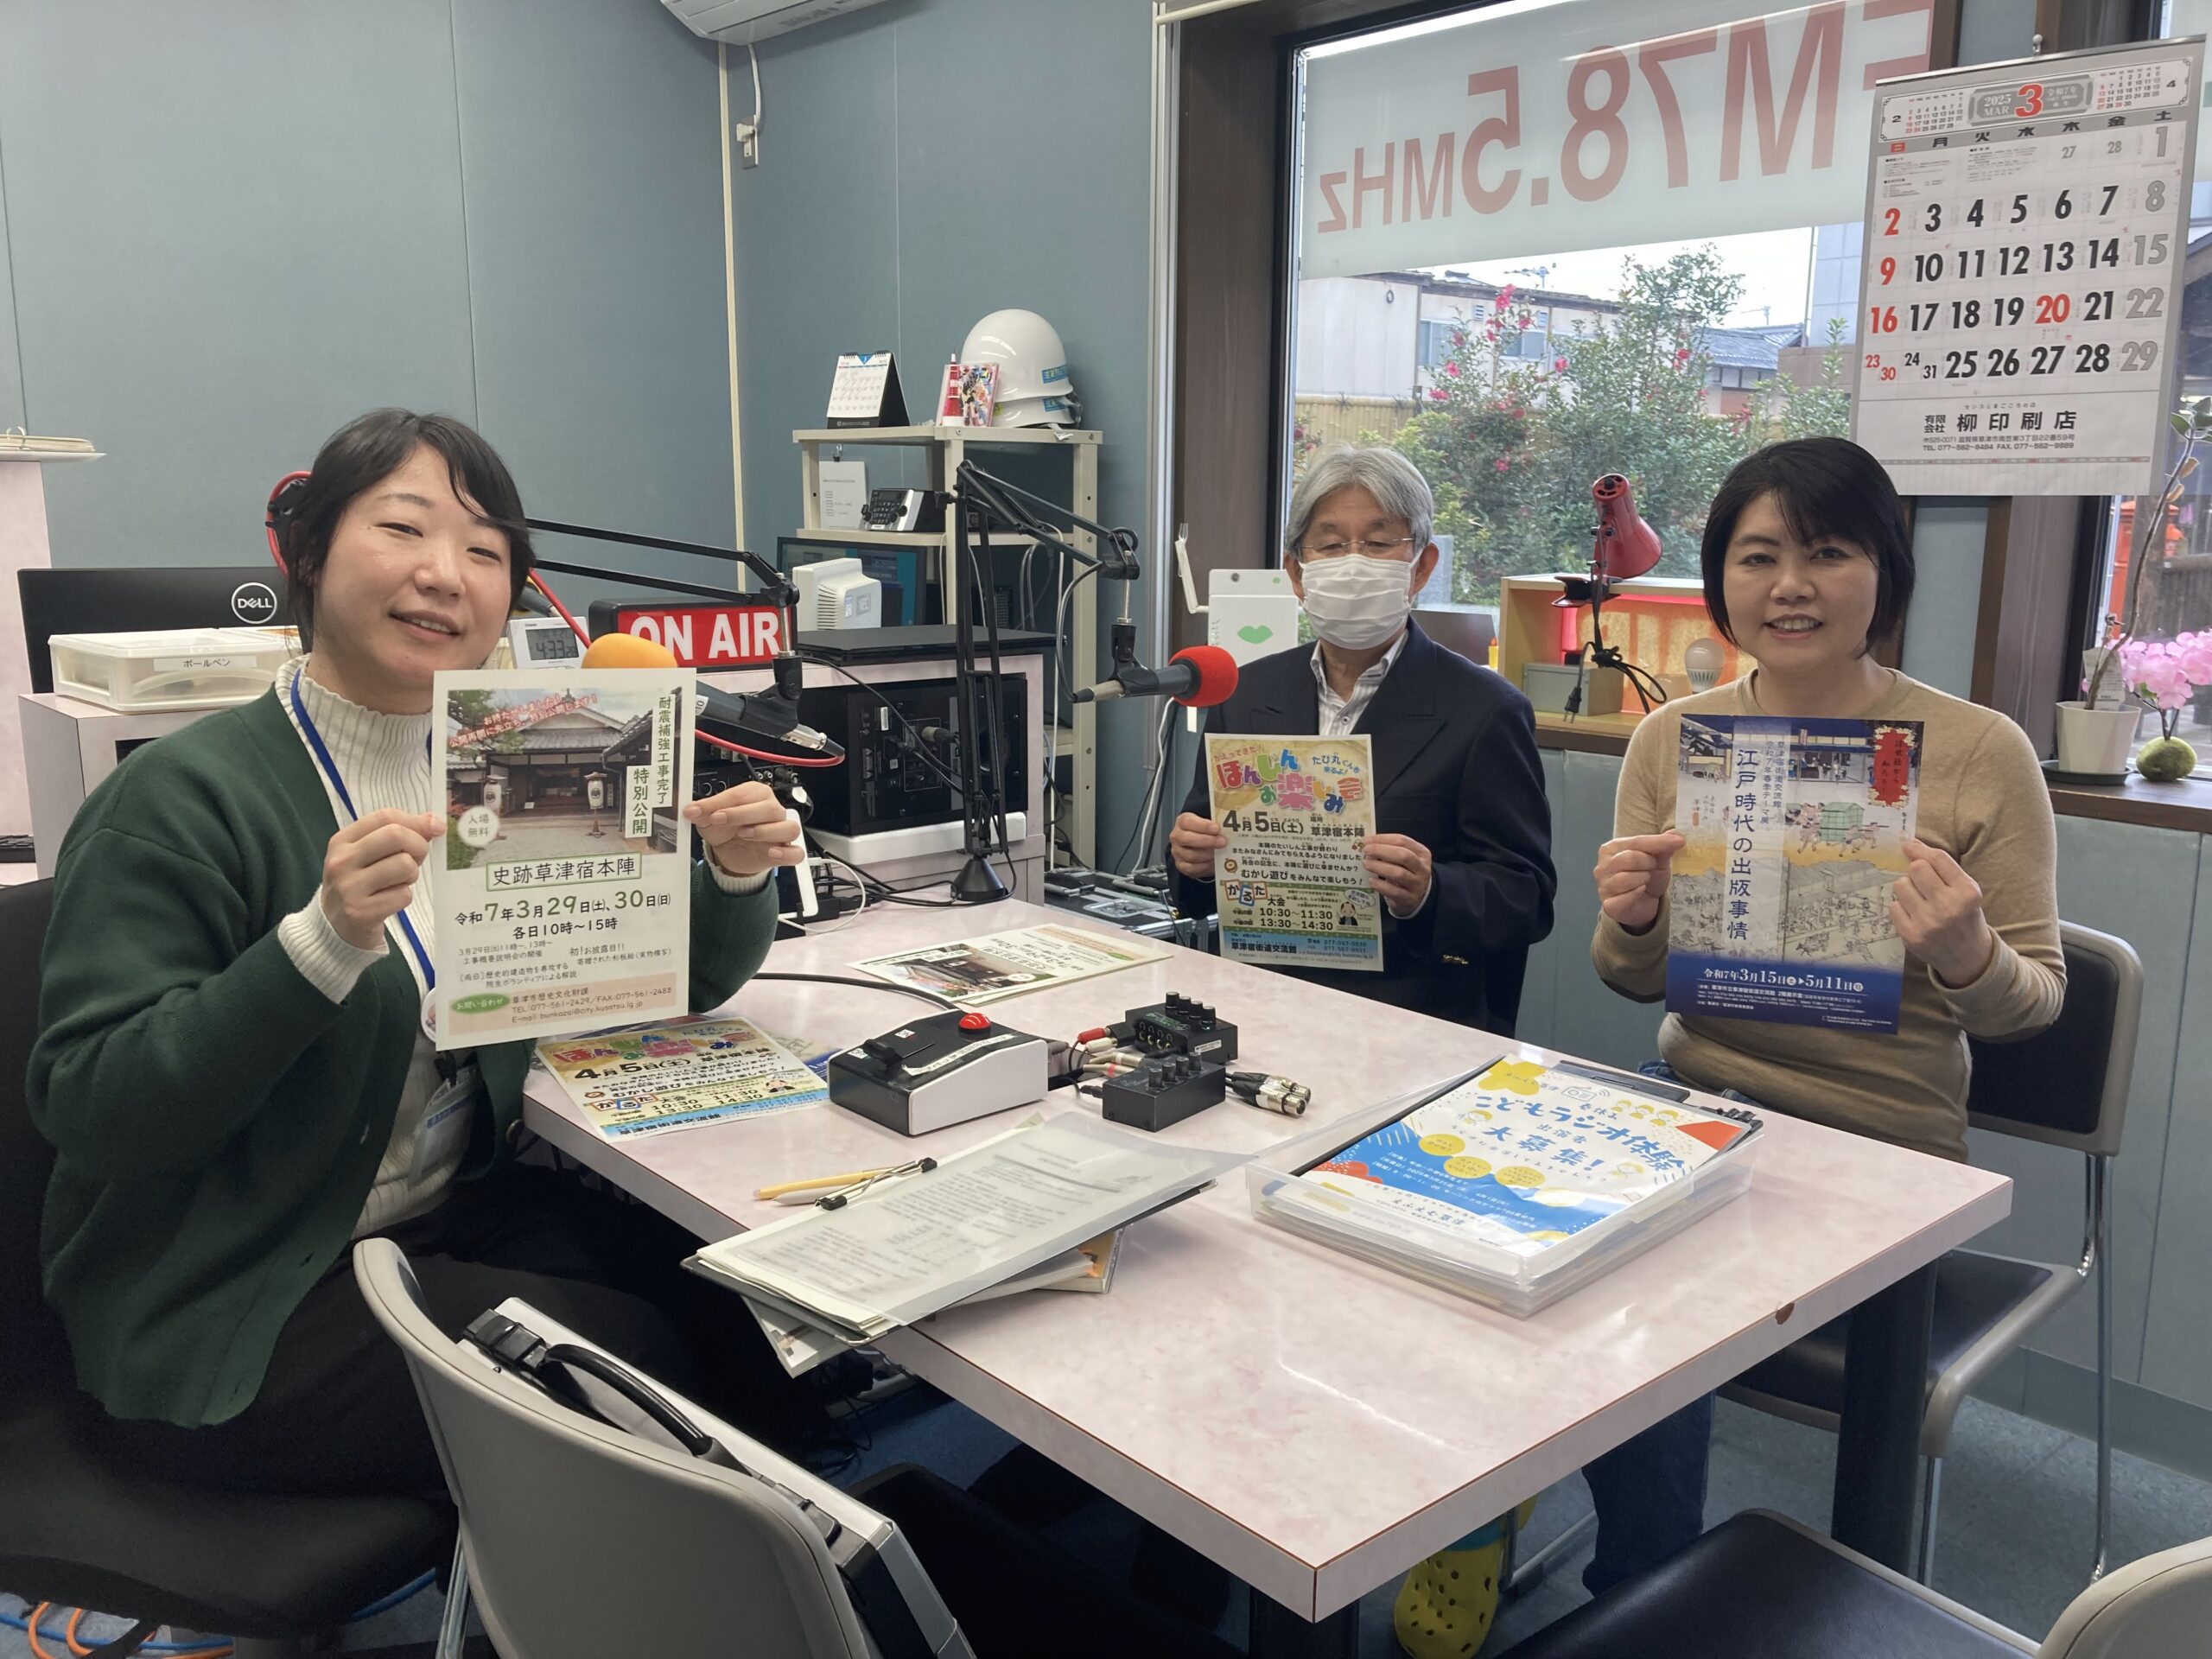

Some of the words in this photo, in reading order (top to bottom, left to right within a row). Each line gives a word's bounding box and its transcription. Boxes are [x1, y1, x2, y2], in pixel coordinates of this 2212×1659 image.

[1984, 93, 2012, 107] 2025
[1984, 106, 2010, 117] MAR
[2015, 84, 2044, 118] 3
[1891, 143, 1905, 153] 日
[1932, 137, 1948, 148] 月
[1974, 132, 1990, 143] 火
[2018, 127, 2035, 137] 水
[2063, 122, 2080, 132] 木
[2107, 116, 2126, 127] 金
[2154, 111, 2172, 122] 土
[2061, 145, 2076, 159] 27
[2107, 141, 2122, 154] 28
[2156, 126, 2168, 157] 1
[1884, 207, 1901, 236] 2
[1925, 204, 1942, 232] 3
[1967, 199, 1984, 227] 4
[2010, 194, 2028, 224] 5
[2055, 189, 2072, 219] 6
[2099, 185, 2119, 215] 7
[2145, 180, 2164, 213] 8
[1880, 257, 1896, 285] 9
[1915, 253, 1943, 283] 10
[1959, 250, 1985, 278] 11
[1999, 246, 2030, 275] 12
[2044, 241, 2074, 272] 13
[2088, 238, 2119, 269] 14
[2133, 234, 2169, 265] 15
[1871, 306, 1897, 334] 16
[1910, 303, 1940, 332] 17
[1951, 301, 1980, 329] 18
[1994, 297, 2024, 327] 19
[2036, 294, 2070, 324] 20
[2083, 291, 2113, 321] 21
[2126, 288, 2164, 319] 22
[1866, 354, 1880, 368] 23
[1880, 367, 1896, 381] 30
[1904, 352, 1920, 366] 24
[1923, 365, 1937, 379] 31
[1945, 351, 1978, 378] 25
[1987, 349, 2020, 376] 26
[2031, 346, 2066, 374] 27
[2075, 343, 2110, 372] 28
[2120, 340, 2158, 372] 29
[1957, 411, 2076, 432] 柳印刷店
[238, 598, 273, 609] DELL
[630, 616, 692, 661] ON
[708, 612, 779, 659] AIR
[183, 658, 231, 668] ボールペン
[658, 696, 672, 805] 耐震補強工事完了
[1217, 748, 1300, 789] ほんじん
[632, 767, 650, 835] 特別公開
[1259, 772, 1363, 815] お楽しみ会
[467, 826, 488, 837] 無料
[468, 813, 489, 824] 入場
[1223, 810, 1304, 834] 4月5日(土)
[1311, 827, 1365, 837] 草津宿本陣
[1726, 749, 1759, 941] 江戸時代の出版事情
[493, 857, 636, 887] 史跡草津宿本陣
[1242, 869, 1363, 885] むかし遊びをみんなで楽しもう!
[1227, 884, 1266, 902] かるた
[1268, 897, 1285, 906] 大会
[456, 998, 505, 1010] お問い合わせ
[575, 1058, 691, 1079] 4月5日(土)
[1476, 1095, 1685, 1173] こどもラジオ体験
[1483, 1126, 1605, 1172] 大募集!
